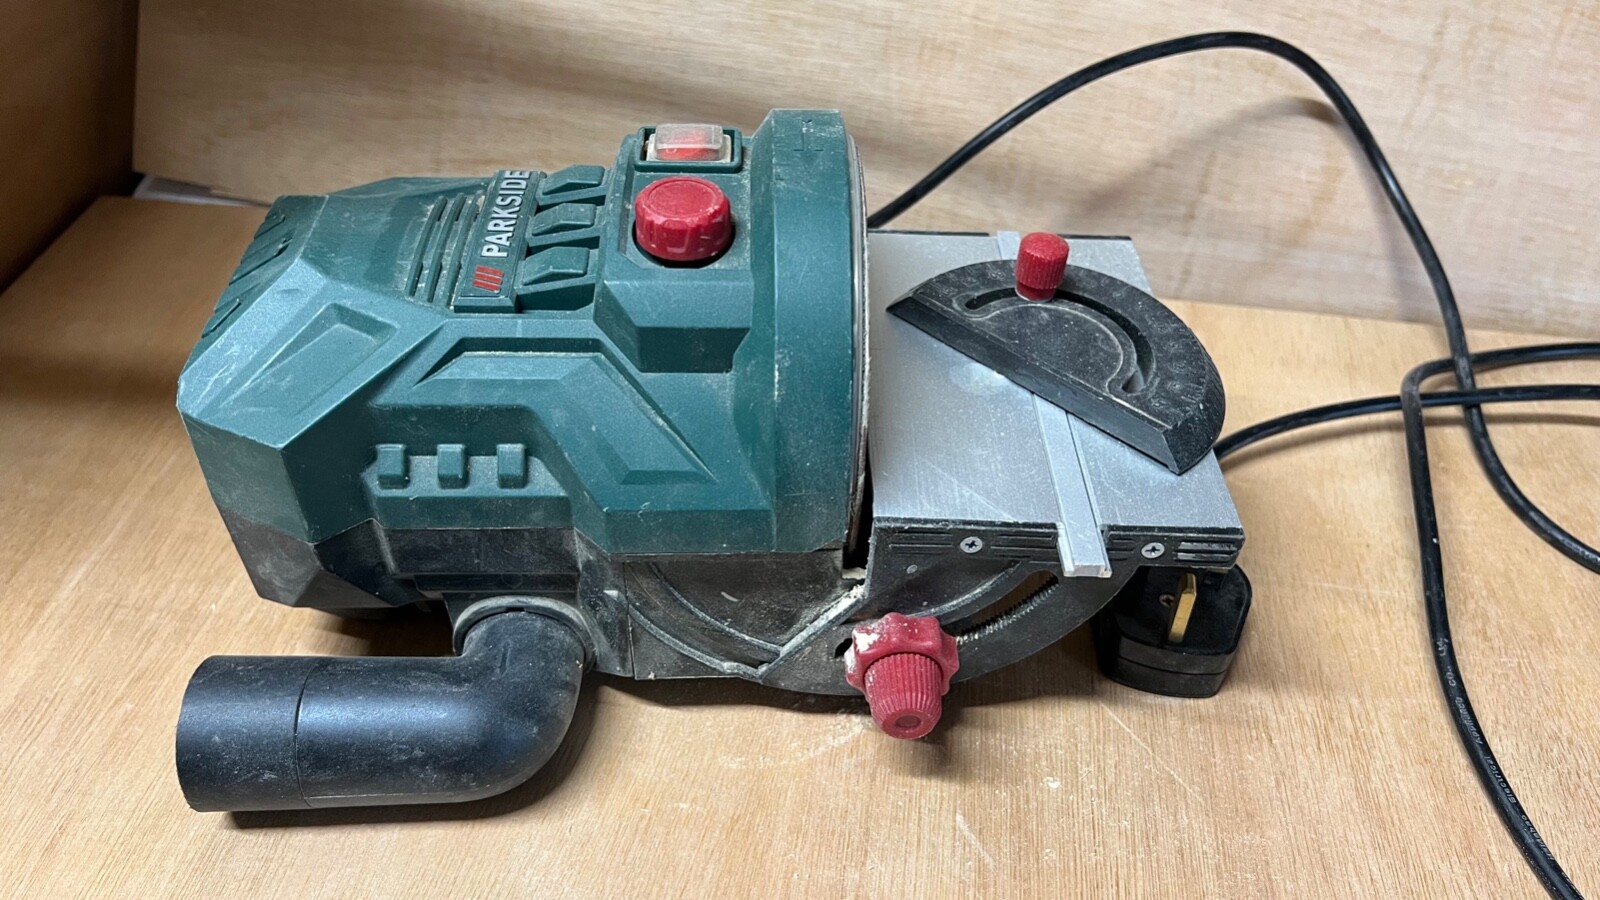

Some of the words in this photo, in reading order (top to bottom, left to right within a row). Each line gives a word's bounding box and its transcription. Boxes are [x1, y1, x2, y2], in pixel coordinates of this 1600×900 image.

[480, 170, 531, 258] PARKSIDE
[1455, 696, 1483, 745] Appliance
[1484, 756, 1517, 803] Electrical
